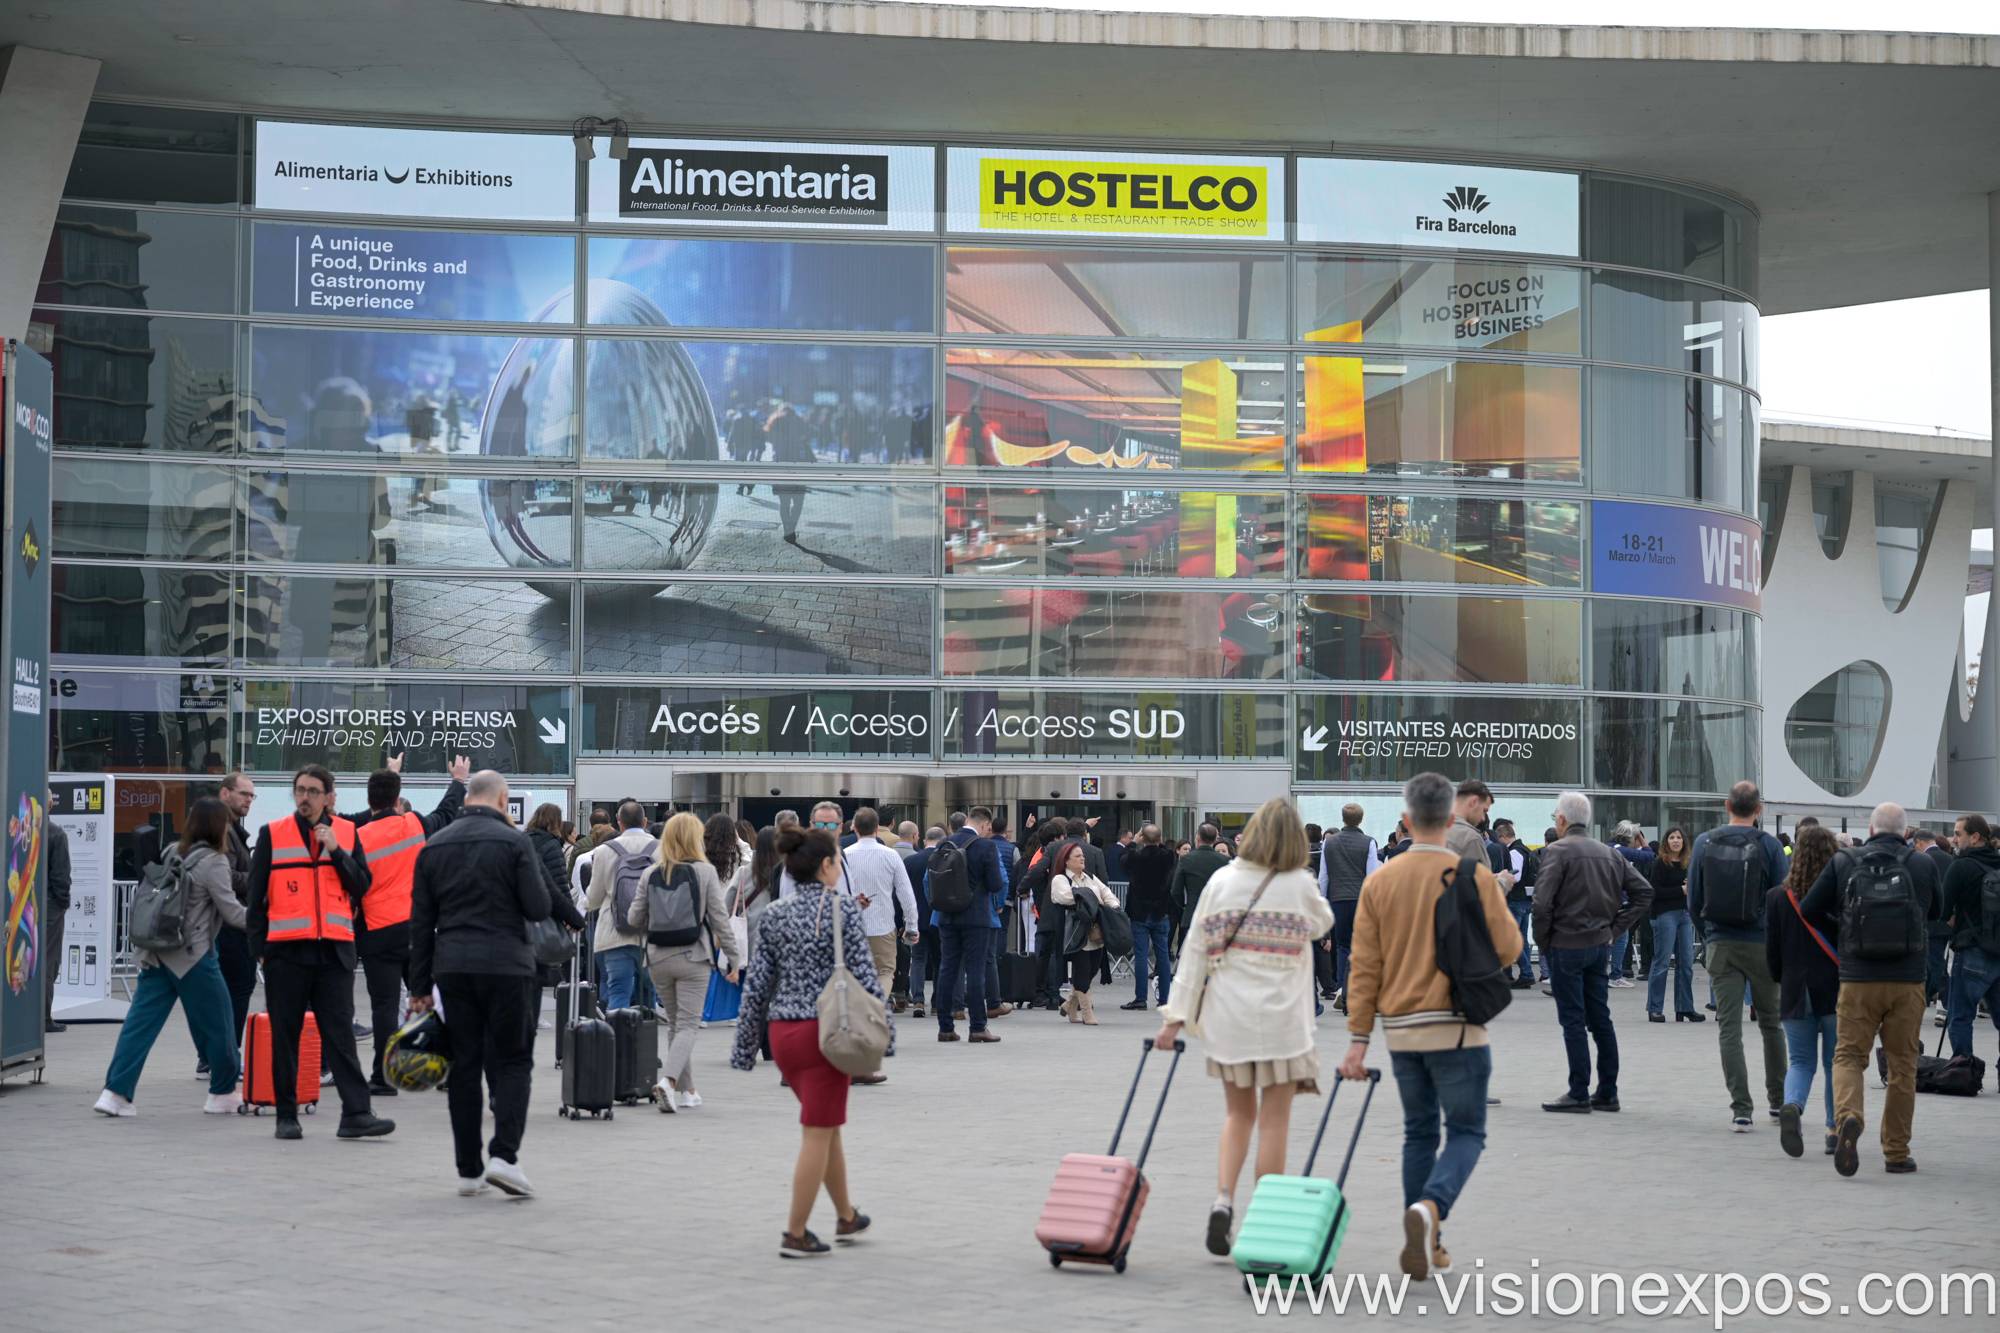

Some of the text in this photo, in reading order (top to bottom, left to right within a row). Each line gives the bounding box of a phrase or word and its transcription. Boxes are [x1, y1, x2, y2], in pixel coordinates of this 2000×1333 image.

[274, 161, 513, 187] Alimentaria Exhibitions
[630, 157, 876, 201] Alimentaria
[993, 170, 1258, 212] HOSTELCO
[630, 200, 875, 216] International Food, Drinks & Food Service Exhibition
[994, 211, 1258, 228] THE HOTEL & RESTAURANT TRADE SHOW
[1416, 215, 1517, 236] Fira Barcelona
[310, 234, 393, 256] A unique
[311, 253, 467, 274] Food, Drinks and
[311, 272, 425, 294] Gastronomy
[1447, 275, 1544, 300] FOCUS ON
[310, 291, 414, 310] Experience
[1423, 294, 1544, 323] HOSPITALITY
[1455, 315, 1544, 339] BUSINESS
[1621, 534, 1664, 551] 18-21
[1608, 550, 1640, 563] Marzo
[1648, 552, 1676, 566] March
[16, 656, 39, 684] HALL 2
[257, 708, 517, 728] EXPOSITORES Y PRENSA
[650, 704, 761, 735] Accés
[780, 705, 795, 736] /
[805, 706, 928, 737] Acceso
[944, 706, 958, 737] /
[975, 709, 1096, 738] Access
[1107, 710, 1185, 739] SUD
[256, 728, 496, 749] EXHIBITORS AND PRESS
[1337, 720, 1576, 740] VISITANTES ACREDITADOS
[1337, 740, 1533, 759] REGISTERED VISITORS
[120, 789, 160, 804] Spain
